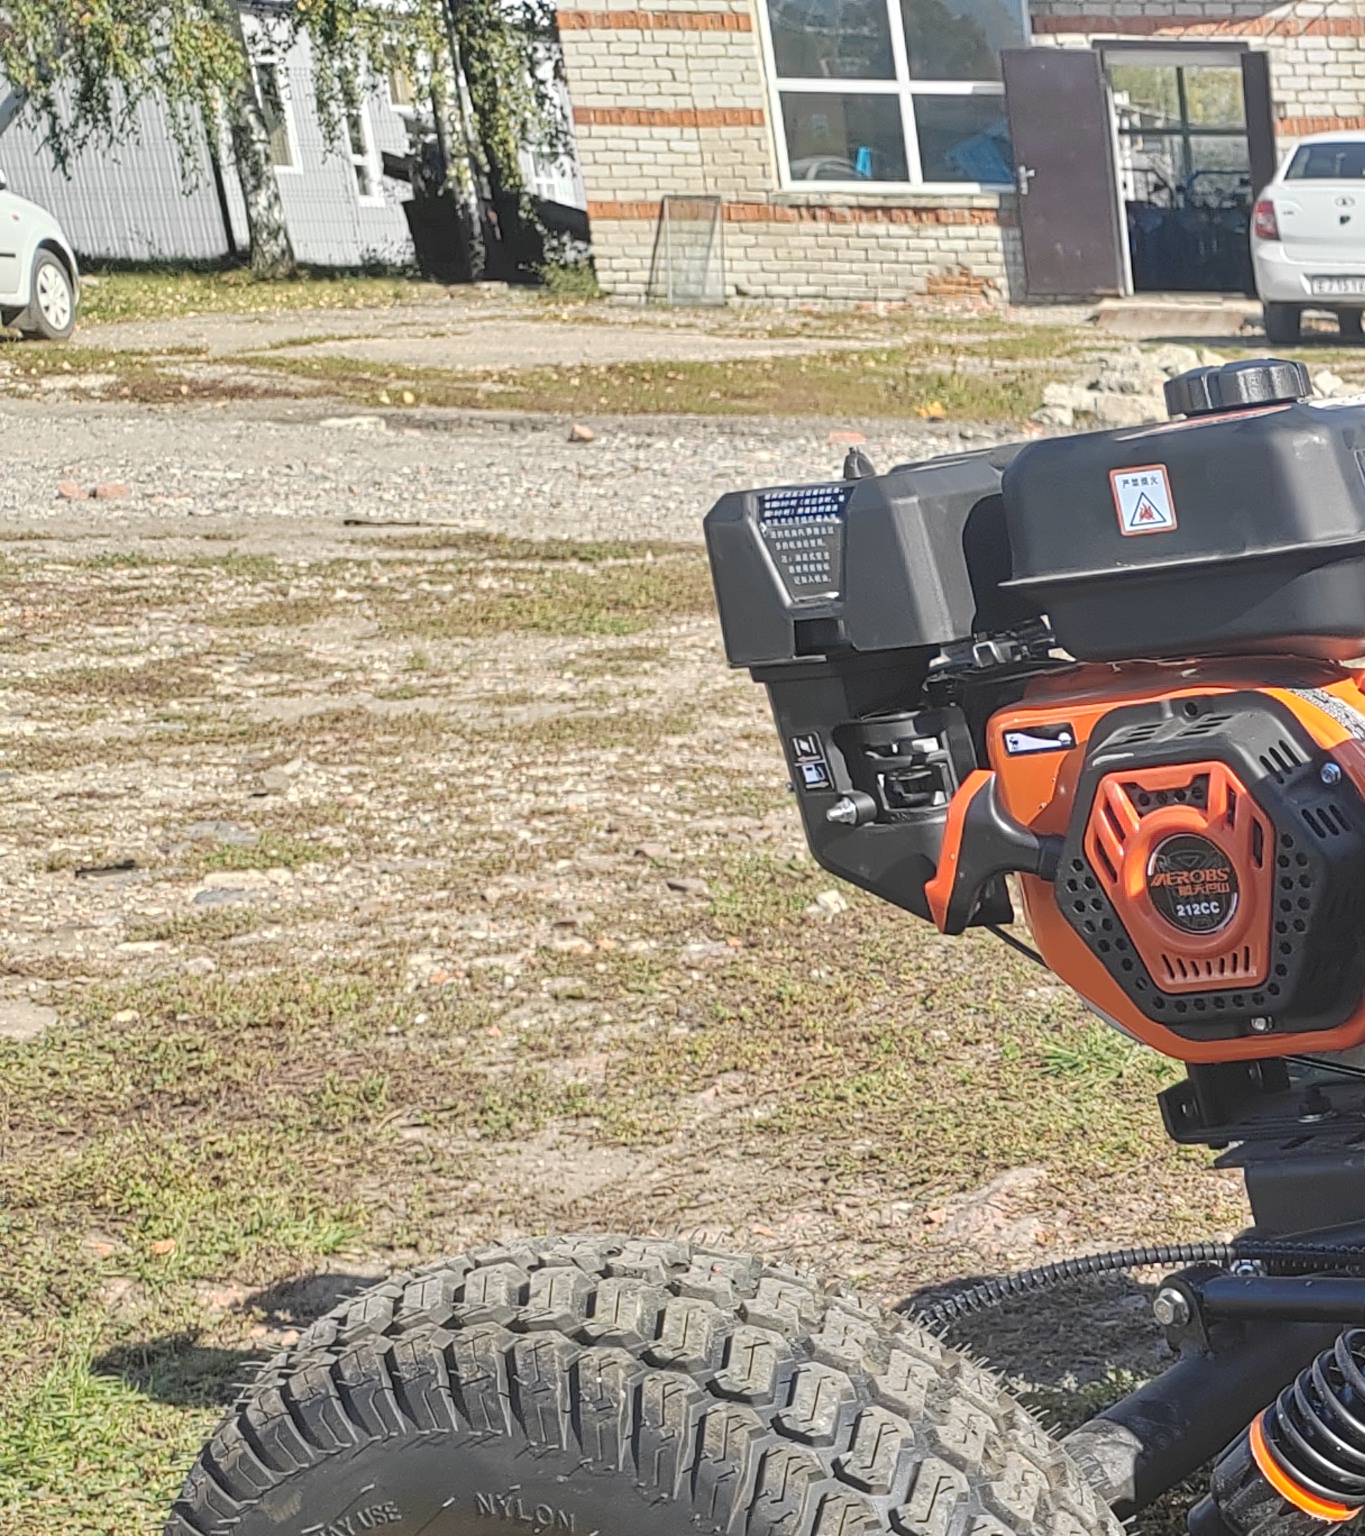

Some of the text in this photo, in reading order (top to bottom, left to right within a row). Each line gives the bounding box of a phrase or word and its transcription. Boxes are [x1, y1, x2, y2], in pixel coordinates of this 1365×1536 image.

[1151, 868, 1229, 887] AEROBS
[1176, 901, 1220, 916] 212CC
[356, 1501, 403, 1529] USE
[476, 1491, 575, 1533] NYLON
